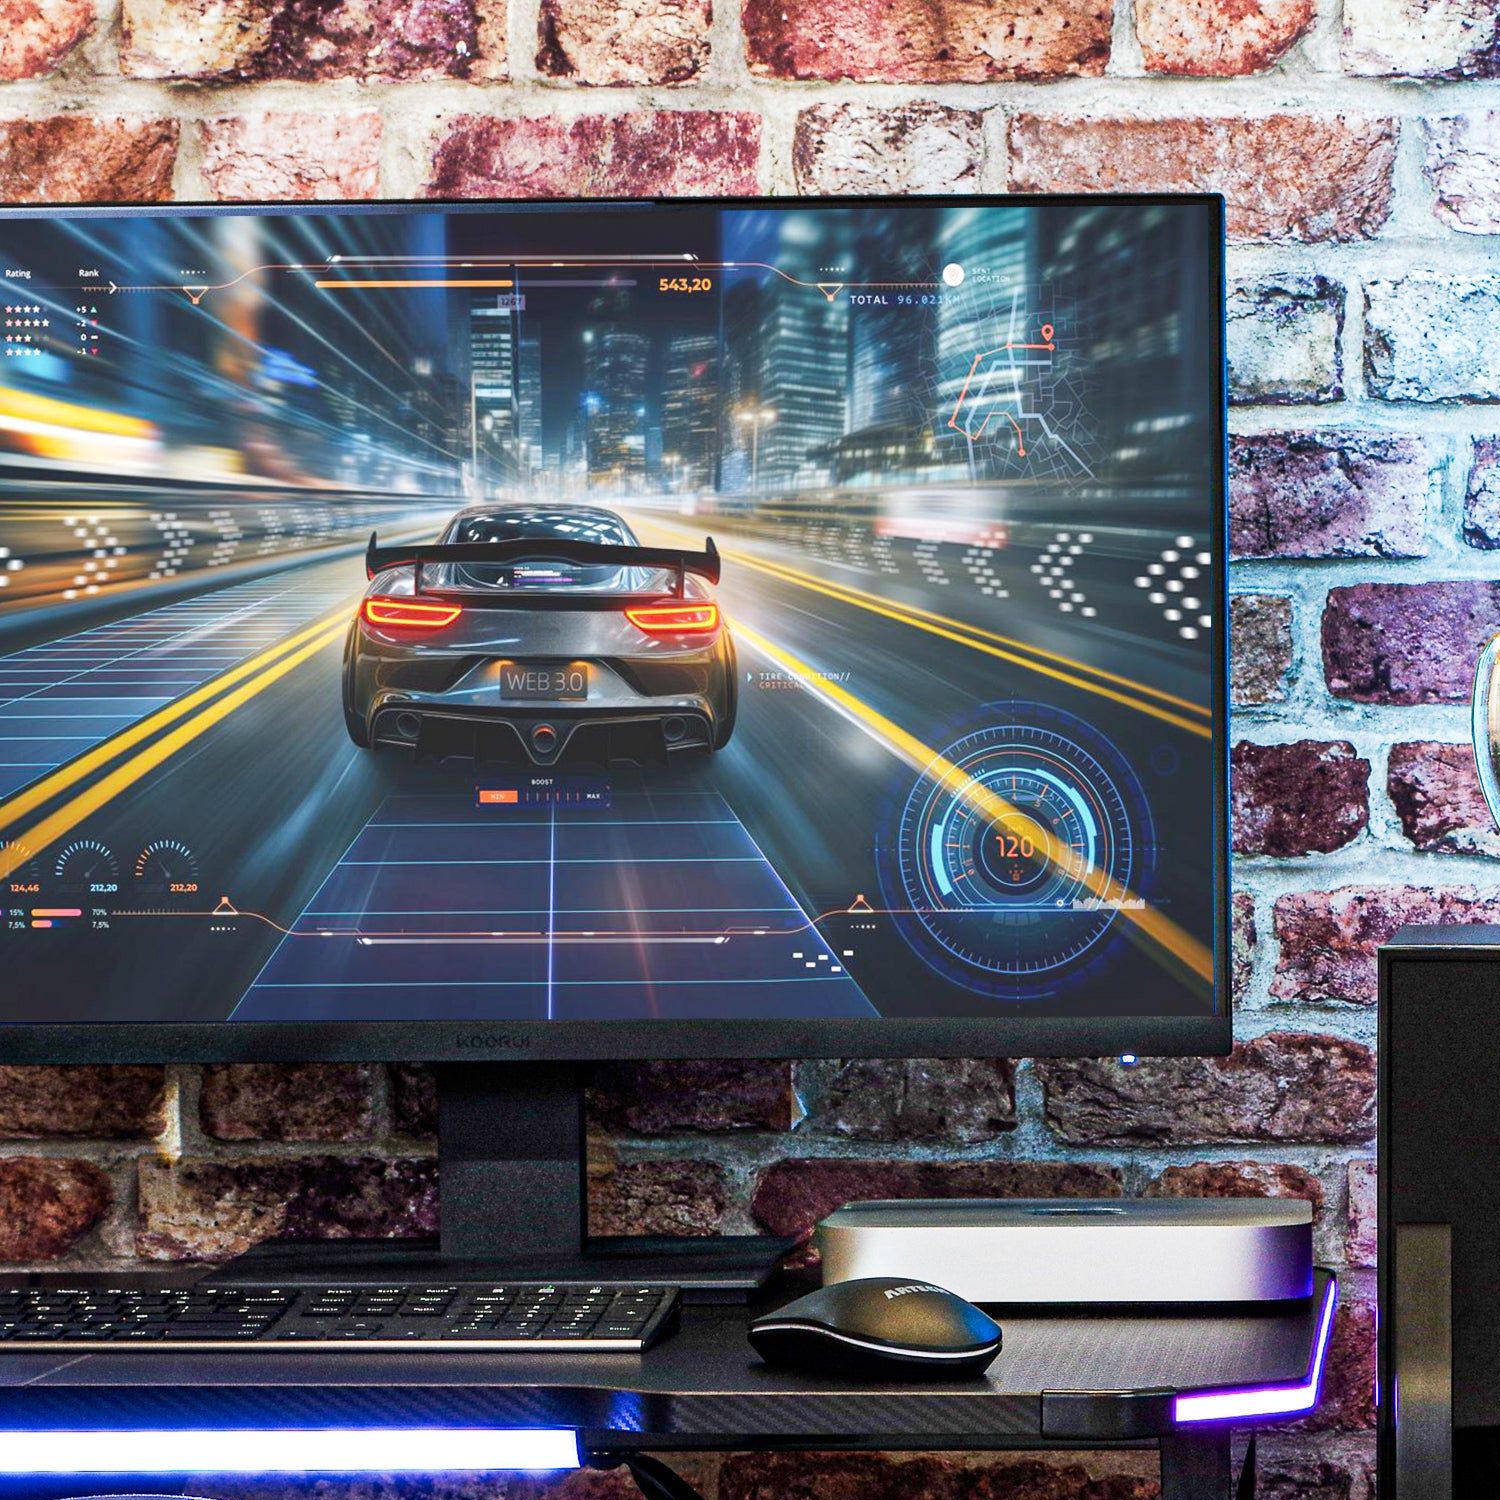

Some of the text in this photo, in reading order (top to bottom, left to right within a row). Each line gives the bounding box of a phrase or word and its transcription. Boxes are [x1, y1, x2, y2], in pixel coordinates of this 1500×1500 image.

[5, 269, 31, 279] Rating
[78, 269, 99, 278] Rank
[659, 278, 712, 293] 543,20
[850, 295, 888, 305] TOTAL
[507, 672, 583, 692] WEB 3.0
[759, 681, 804, 689] CRITICA
[995, 835, 1034, 858] 120
[10, 883, 198, 893] 124,46 212,20 212,20
[9, 908, 107, 917] 15% 70%
[8, 920, 110, 930] 7,5% 7,5%
